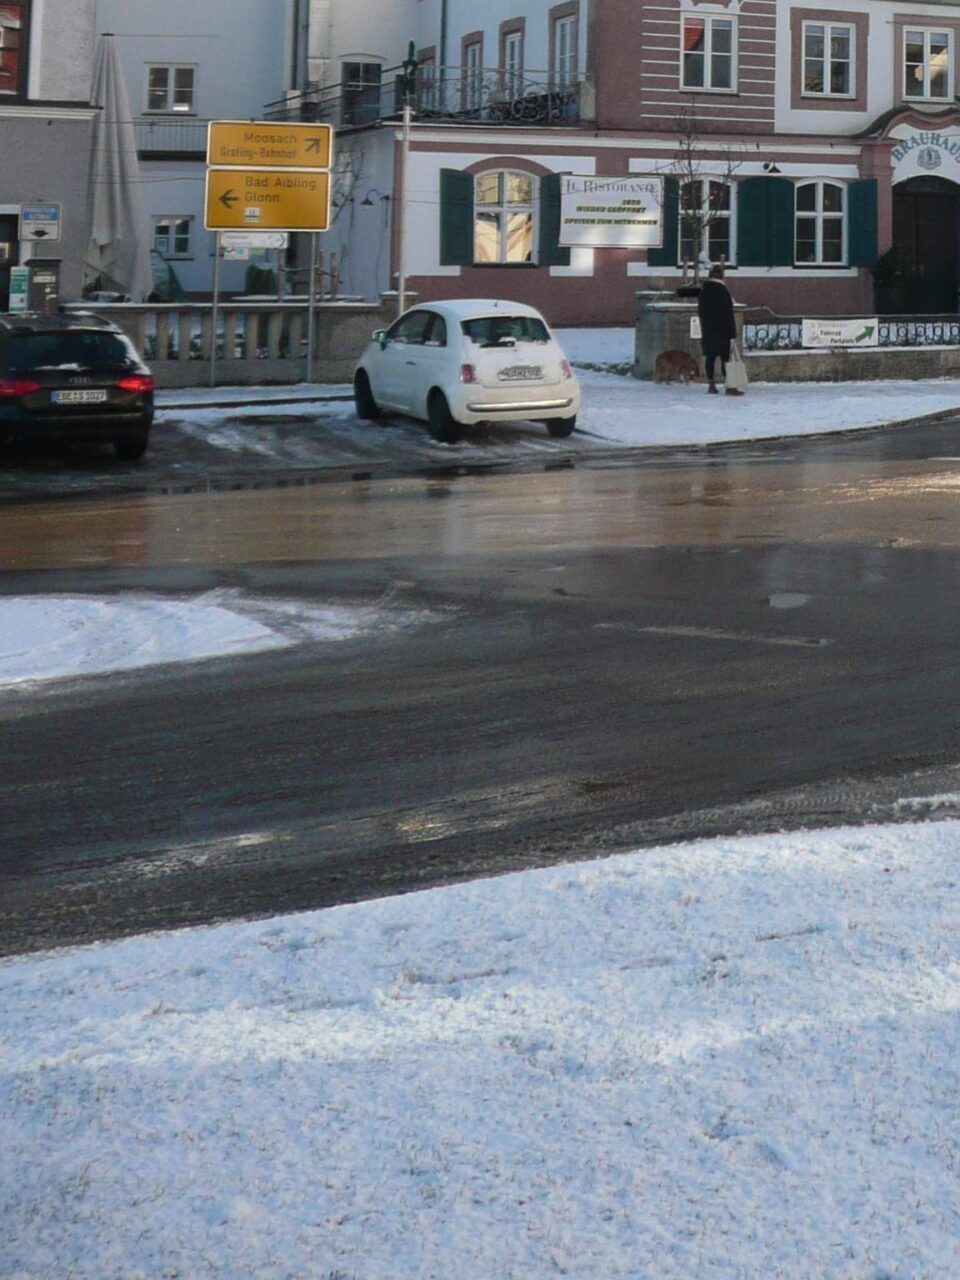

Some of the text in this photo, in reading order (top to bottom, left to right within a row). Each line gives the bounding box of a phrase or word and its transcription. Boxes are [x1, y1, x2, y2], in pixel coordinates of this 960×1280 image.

[243, 131, 298, 145] Moosach
[221, 145, 297, 160] Grafing-Bahnhof
[245, 176, 317, 191] Bad Aibling
[245, 191, 280, 203] Glonn
